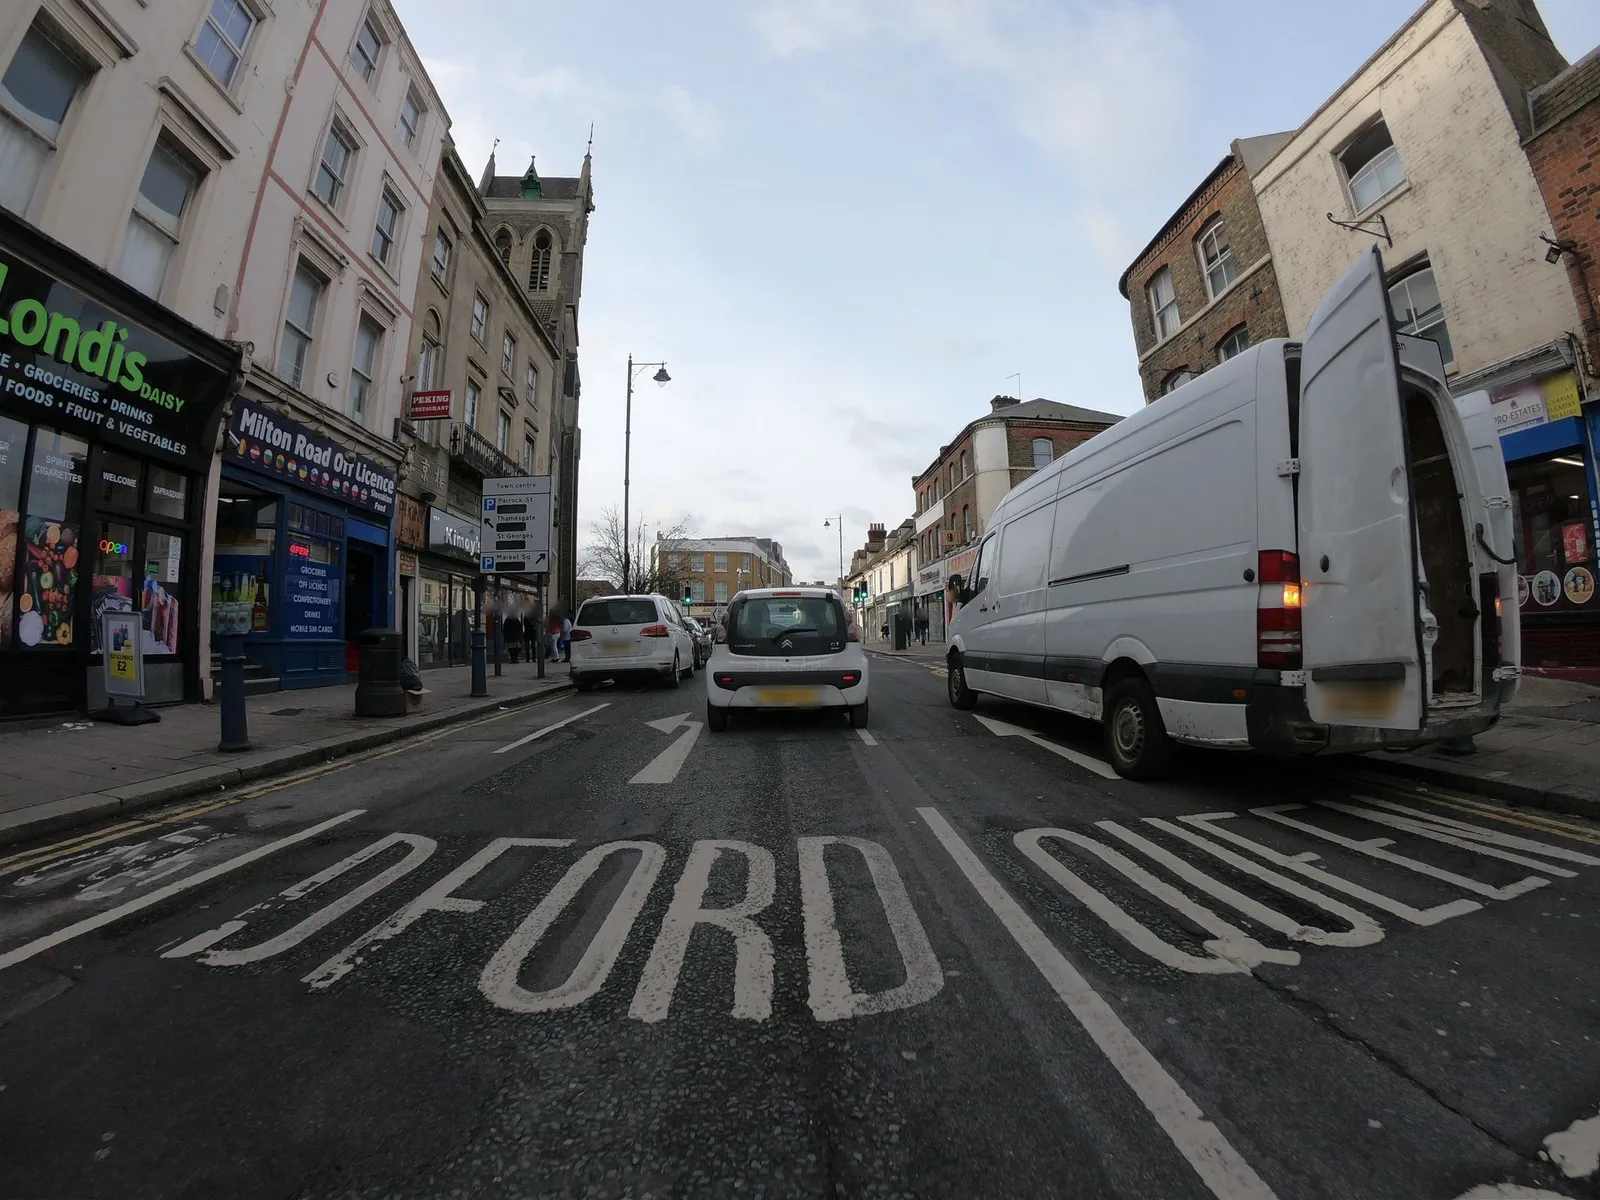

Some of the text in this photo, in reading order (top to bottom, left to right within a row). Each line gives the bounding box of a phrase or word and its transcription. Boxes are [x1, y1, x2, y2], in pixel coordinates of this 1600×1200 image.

[24, 363, 100, 404] GROCERIES
[110, 398, 153, 425] DRINKS
[140, 381, 185, 413] DAISY
[413, 395, 449, 404] PEKING
[411, 405, 449, 413] RESTAURANT
[5, 378, 54, 407] FOODS
[66, 401, 103, 426] FRUIT
[106, 417, 115, 431] &
[119, 421, 187, 456] VEGETABLES
[239, 407, 395, 495] Milton Road Off Licence
[45, 455, 75, 470] SPIRITS
[34, 464, 83, 484] CIGARETTES
[102, 471, 137, 488] WELCOME
[374, 501, 387, 513] Food
[289, 544, 310, 557] OPEN
[300, 565, 327, 577] GROCERIES
[298, 580, 328, 591] OFF LICENCE
[293, 594, 331, 606] CONFECTIONERY
[304, 610, 321, 619] DRINKS
[290, 624, 333, 634] MOBILE SIM CARDS
[117, 661, 127, 672] £2
